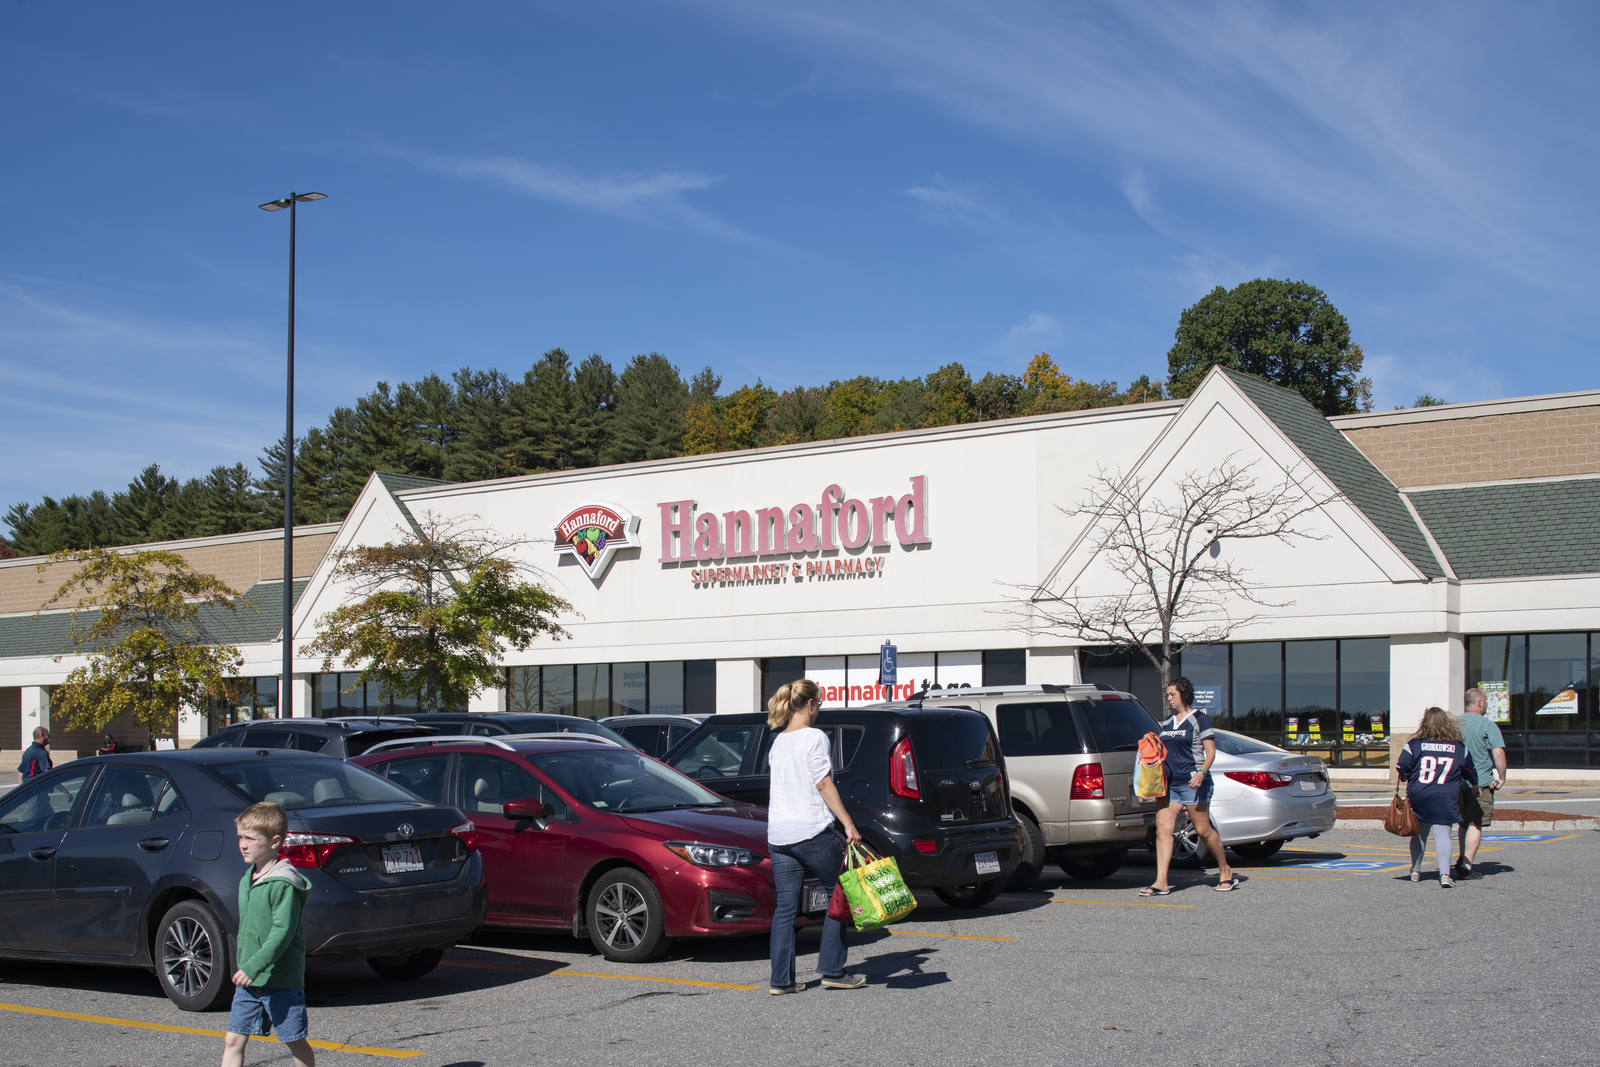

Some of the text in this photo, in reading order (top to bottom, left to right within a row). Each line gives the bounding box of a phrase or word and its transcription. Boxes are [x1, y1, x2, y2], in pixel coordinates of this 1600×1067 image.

[560, 510, 620, 538] Hannaford
[657, 475, 930, 563] Hannaford
[691, 556, 882, 584] SUPERMARKET & PHARMACY
[1418, 755, 1454, 785] 87
